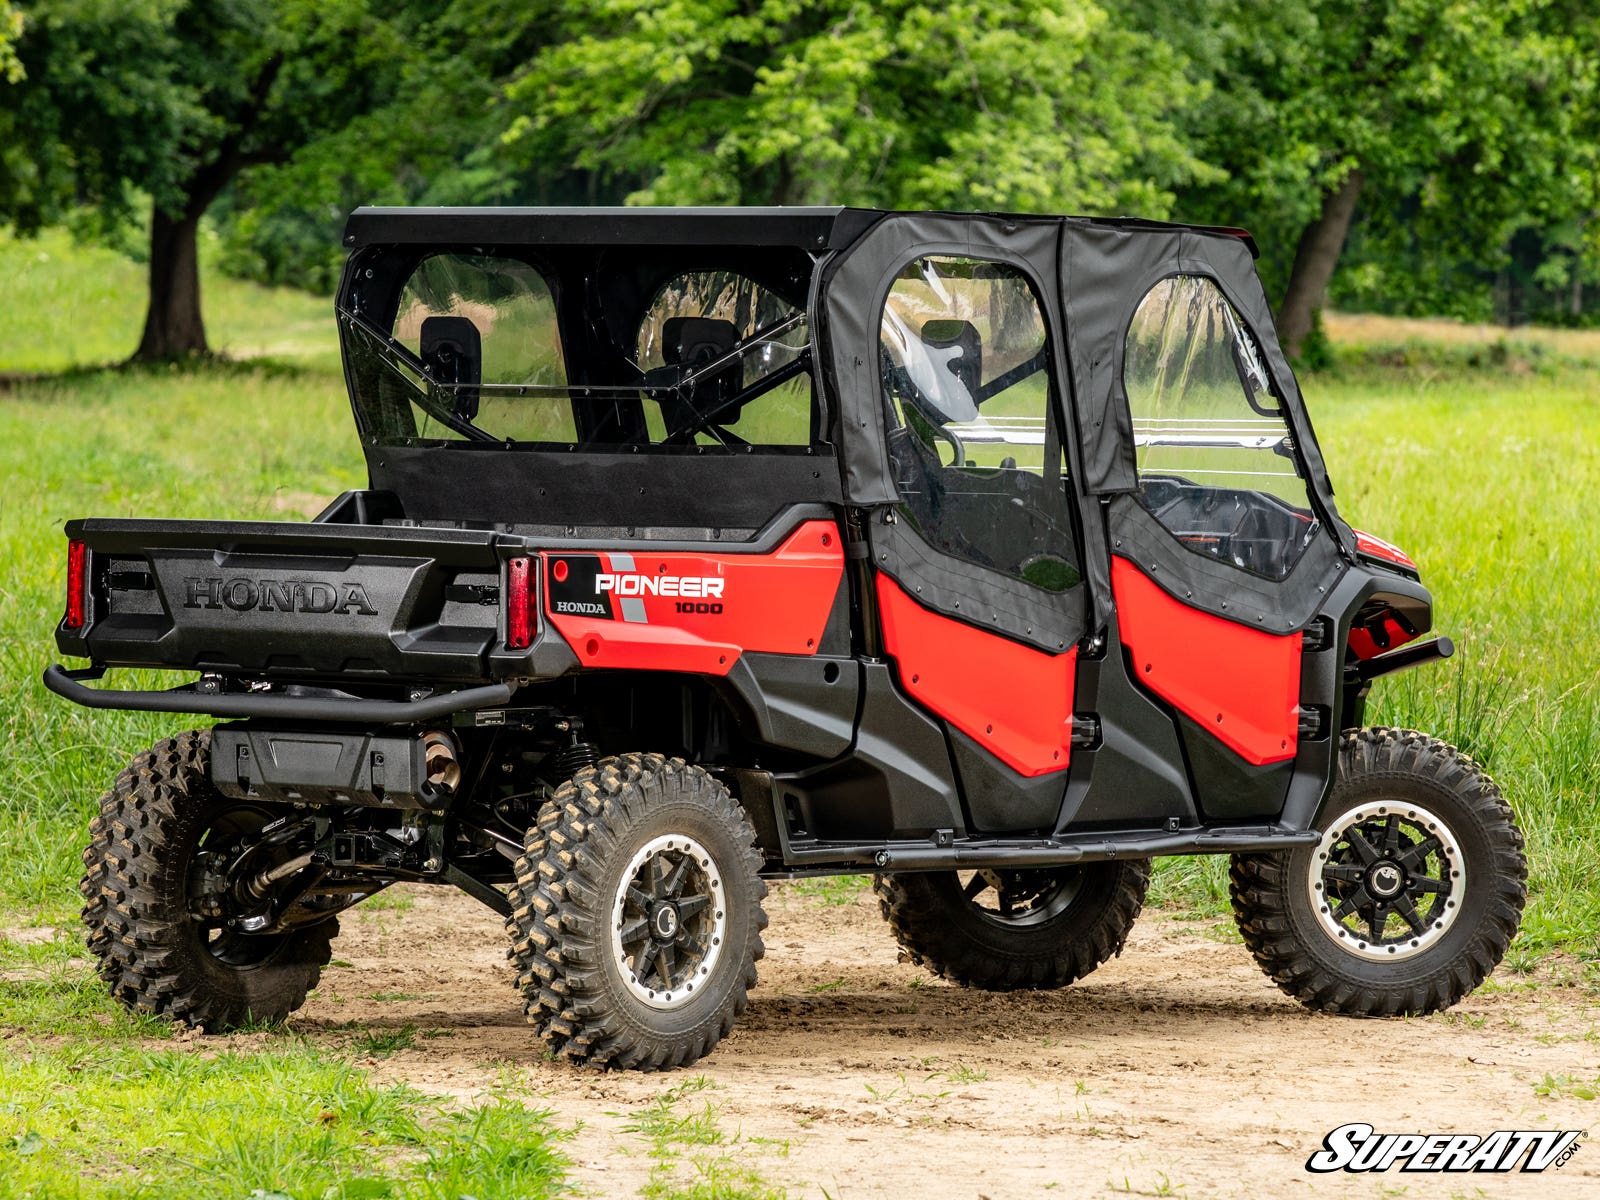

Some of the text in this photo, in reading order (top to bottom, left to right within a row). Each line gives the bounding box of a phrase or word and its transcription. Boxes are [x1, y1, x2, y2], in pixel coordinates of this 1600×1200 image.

[183, 575, 377, 615] HONDA
[595, 573, 724, 599] PIONEER
[556, 601, 607, 615] HONDA
[675, 602, 723, 614] 1000
